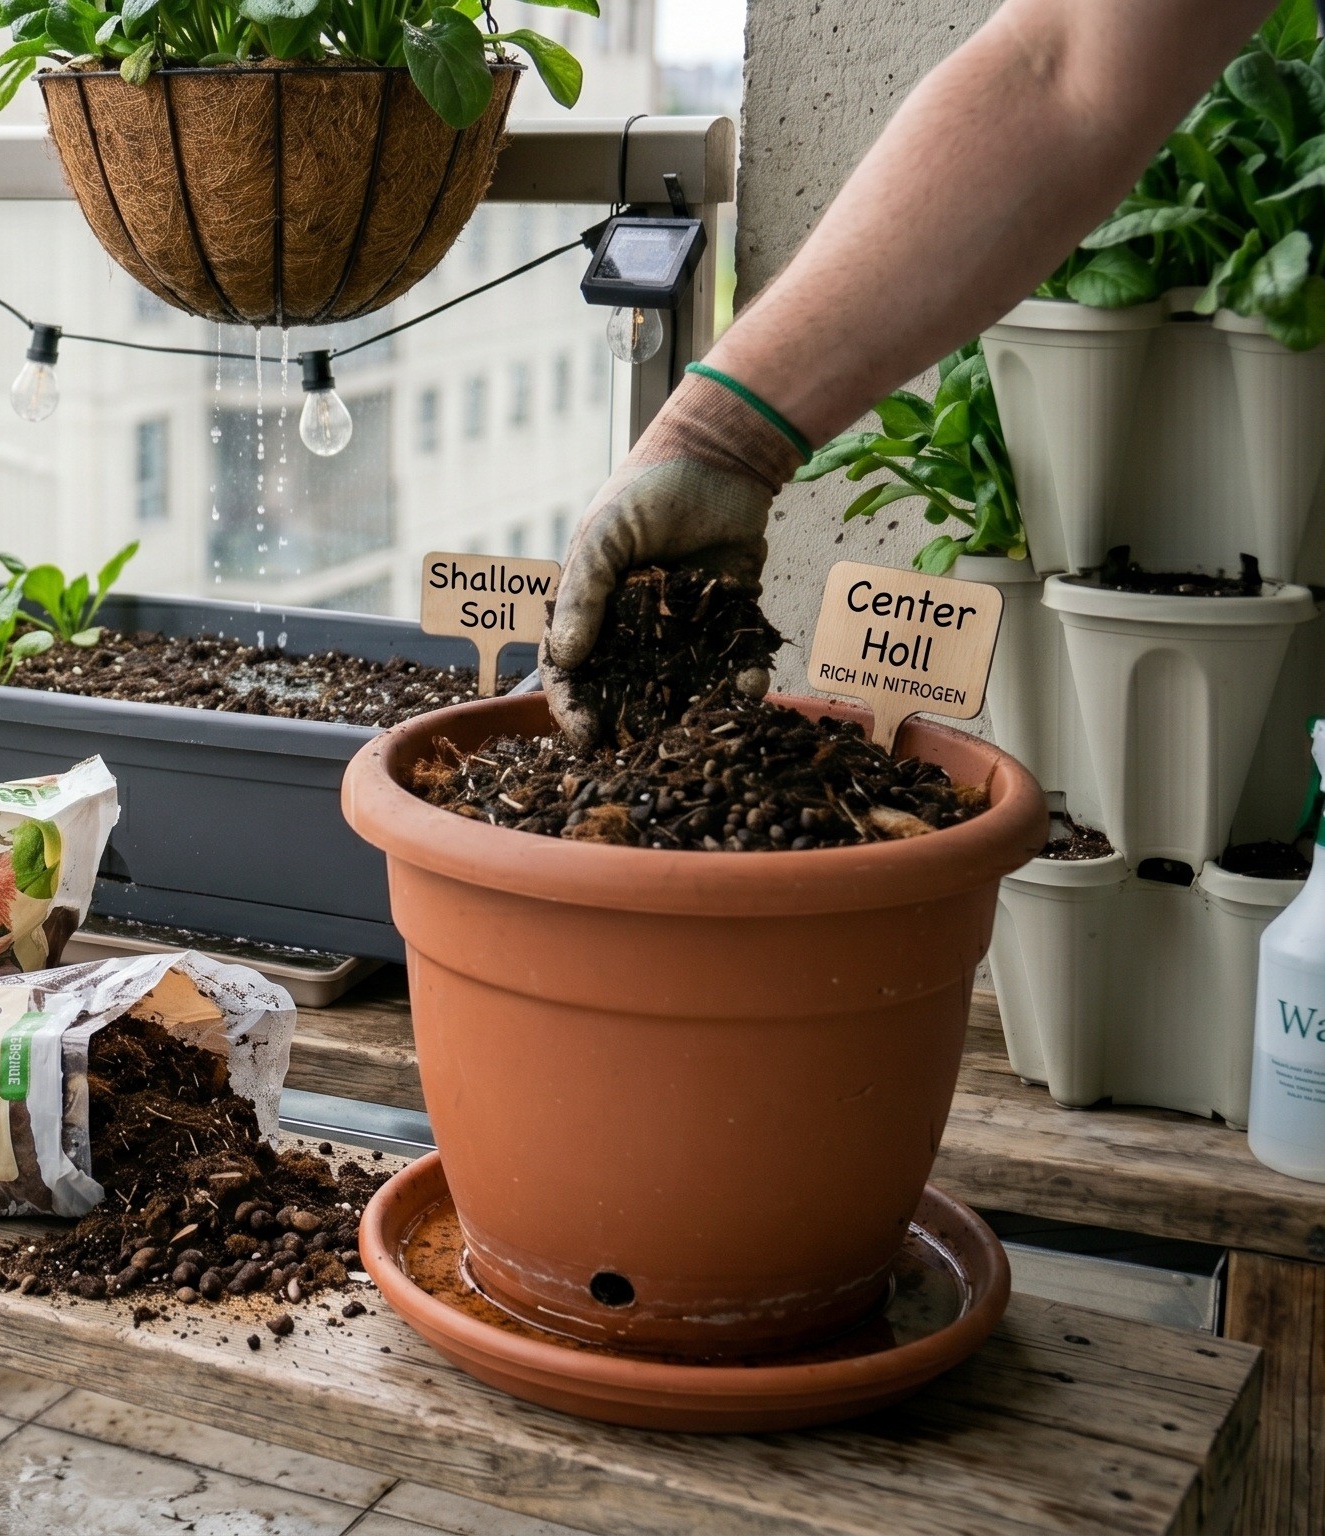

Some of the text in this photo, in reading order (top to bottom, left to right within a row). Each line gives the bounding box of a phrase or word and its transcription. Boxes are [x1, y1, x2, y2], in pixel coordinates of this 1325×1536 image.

[429, 561, 552, 597] Shallow
[460, 601, 516, 631] Soil
[847, 580, 977, 630] Center
[861, 627, 934, 672] Holl
[819, 663, 967, 705] RICH IN NITROGEN
